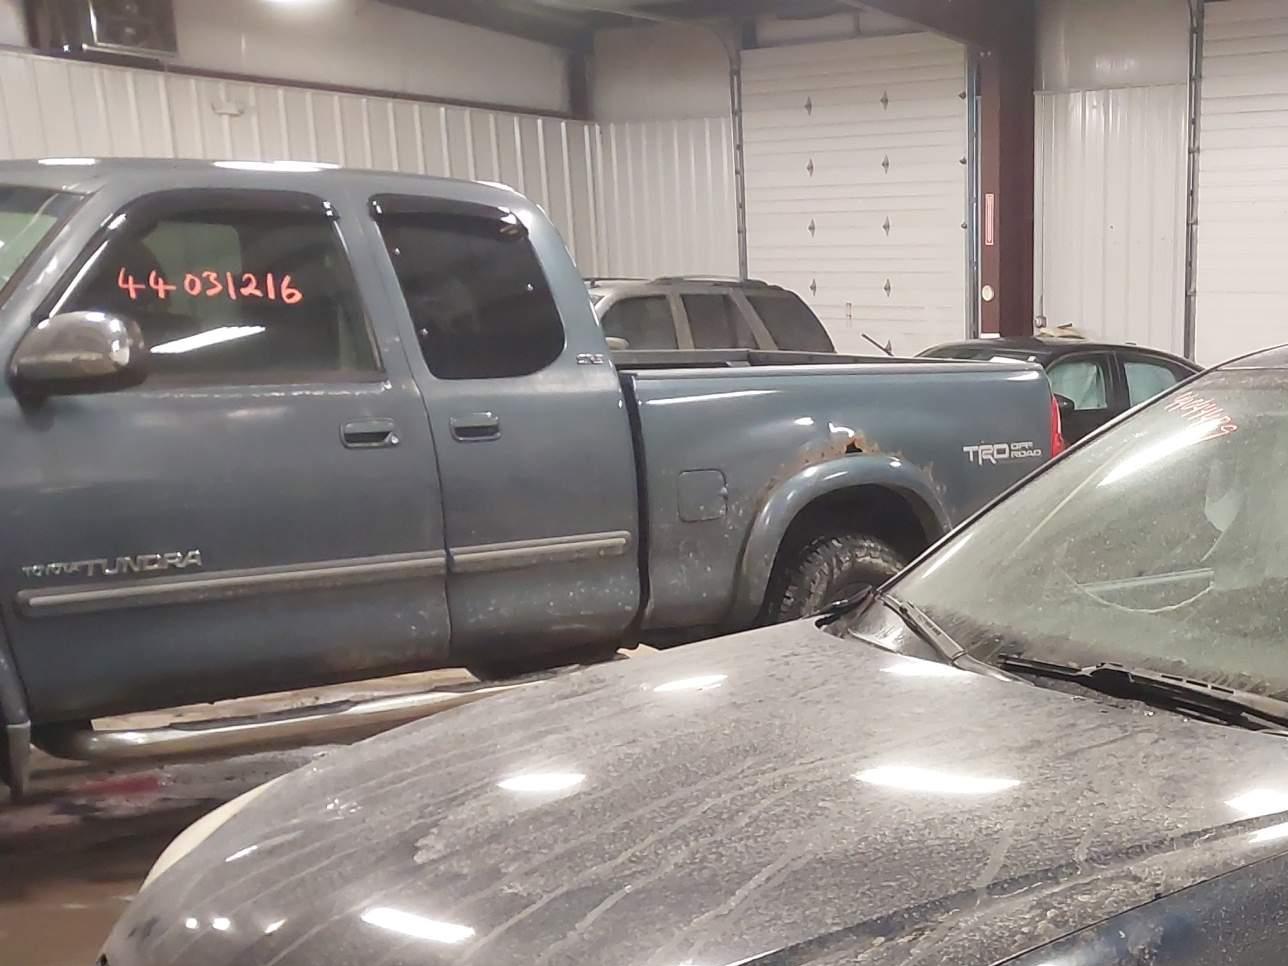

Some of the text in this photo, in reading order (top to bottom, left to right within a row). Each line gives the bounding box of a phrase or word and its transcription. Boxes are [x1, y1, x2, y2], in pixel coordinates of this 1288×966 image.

[117, 267, 303, 304] 44031216
[962, 443, 1010, 466] TRD
[1010, 441, 1033, 450] OFF
[1010, 449, 1042, 458] ROAD
[79, 549, 202, 577] TUNDRA
